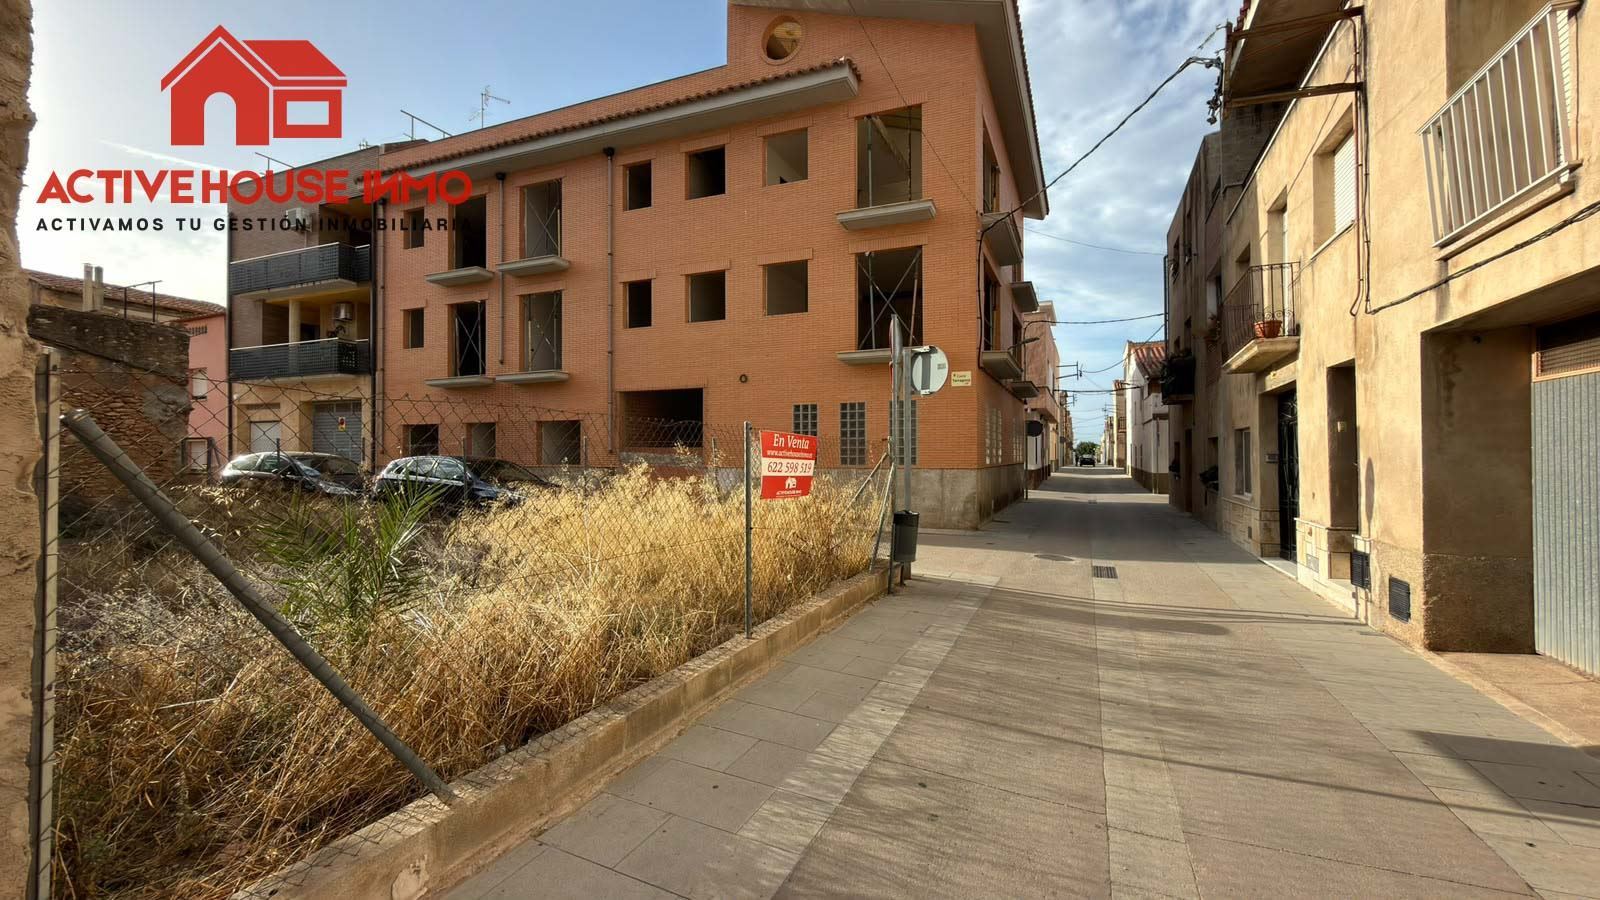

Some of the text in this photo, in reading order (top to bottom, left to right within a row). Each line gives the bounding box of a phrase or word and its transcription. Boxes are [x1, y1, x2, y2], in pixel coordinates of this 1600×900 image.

[773, 433, 810, 449] En Venta
[767, 461, 812, 473] 622 598 519
